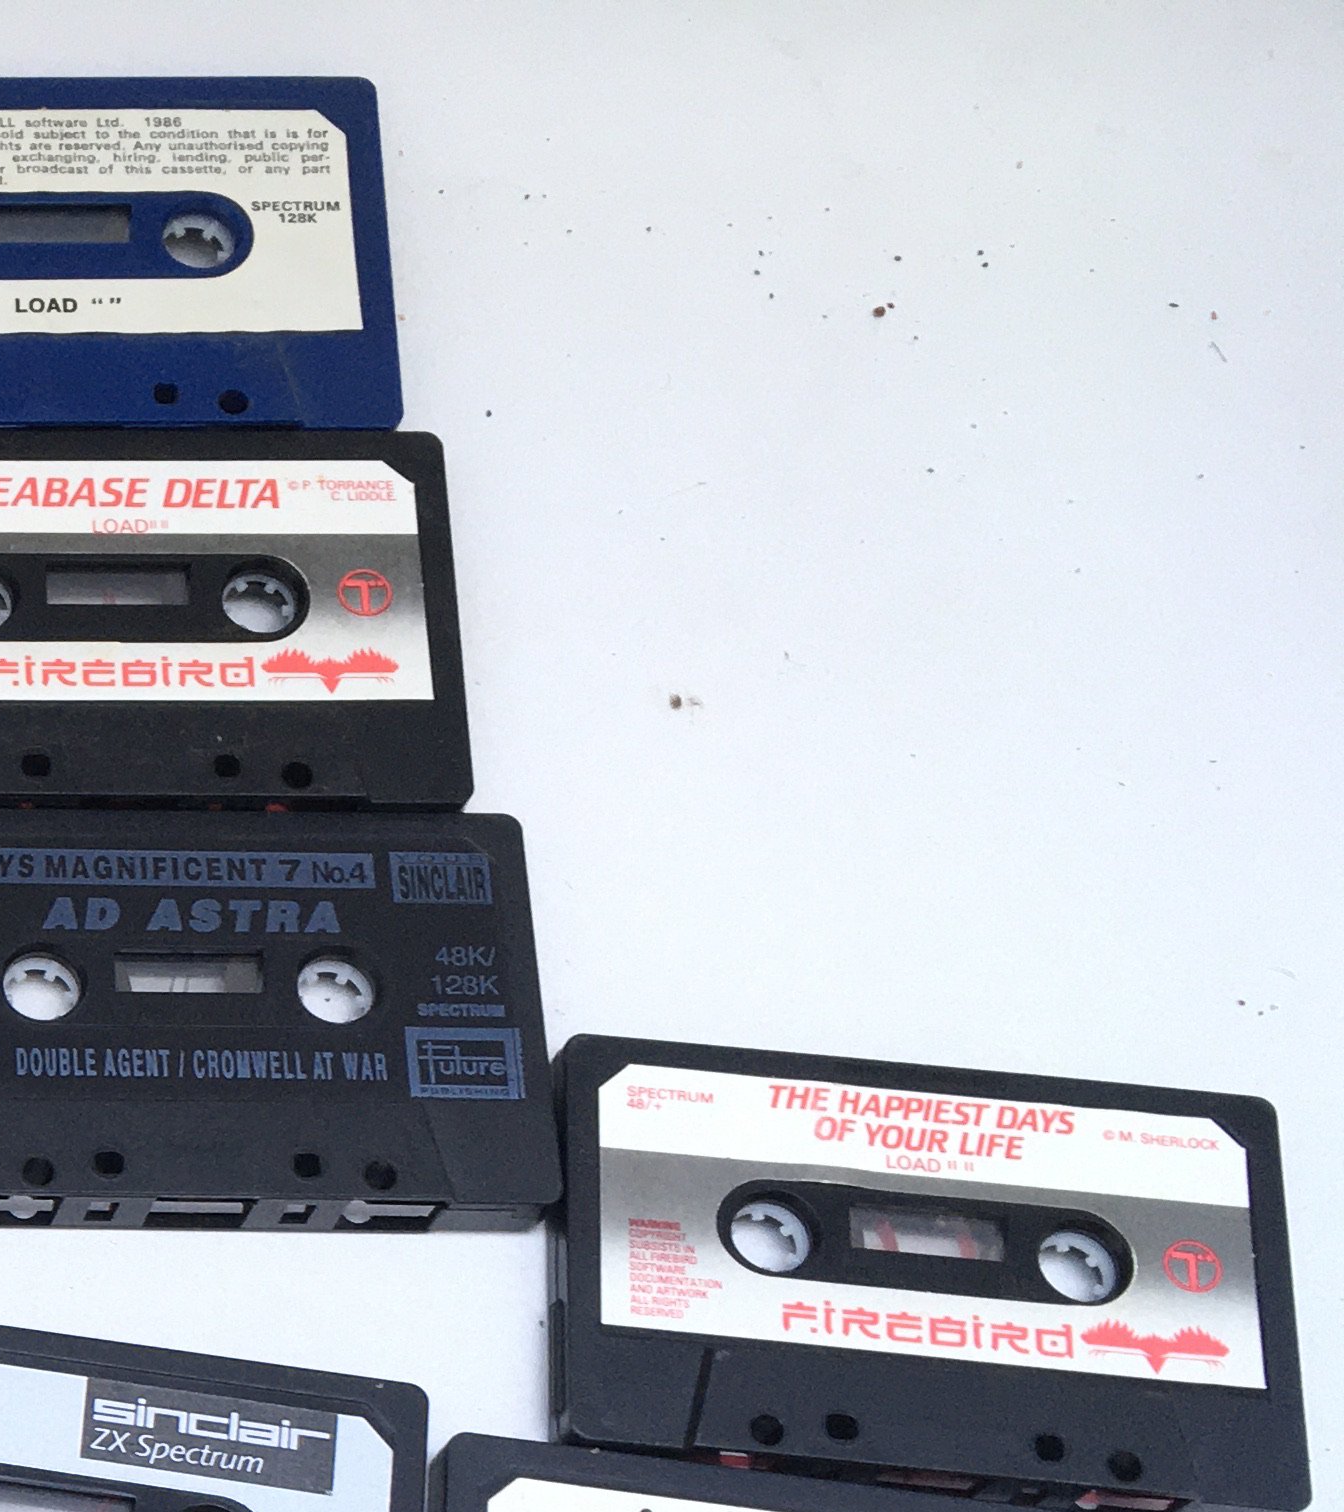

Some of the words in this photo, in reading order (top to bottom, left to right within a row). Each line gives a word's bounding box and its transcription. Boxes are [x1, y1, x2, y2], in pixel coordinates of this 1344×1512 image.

[24, 117, 89, 128] software
[97, 117, 125, 127] Ltd.
[144, 117, 182, 127] 1986
[252, 201, 340, 212] SPECTRUM
[278, 214, 318, 224] 128K
[15, 298, 77, 313] LOAD
[164, 478, 279, 508] DELTA
[319, 481, 394, 491] TORRANCE
[347, 490, 395, 502] LIDDLE
[42, 855, 265, 882] MAGNIFICENT
[277, 859, 301, 881] 7
[312, 861, 366, 885] No.4
[397, 863, 487, 900] SINCLAIR
[43, 897, 121, 931] AD
[147, 899, 342, 933] ASTRA
[434, 945, 497, 966] 48K/
[430, 974, 500, 995] 128K
[16, 1048, 97, 1078] DOUBLE
[104, 1049, 171, 1079] AGENT
[193, 1050, 308, 1080] CROMWELL
[313, 1051, 338, 1080] AT
[342, 1052, 388, 1081] WAR
[627, 1087, 714, 1103] SPECTRUM
[769, 1085, 831, 1113] THE
[838, 1091, 987, 1128] HAPPIEST
[996, 1104, 1075, 1136] DAYS
[814, 1115, 857, 1142] OF
[864, 1119, 952, 1154] YOUR
[958, 1130, 1024, 1160] LIFE
[1119, 1132, 1135, 1142] M.
[1140, 1133, 1219, 1150] SHERLOCK
[885, 1155, 941, 1173] LOAD
[93, 1397, 331, 1451] sinclair
[91, 1428, 127, 1454] ZX
[135, 1436, 264, 1475] Spectrum
